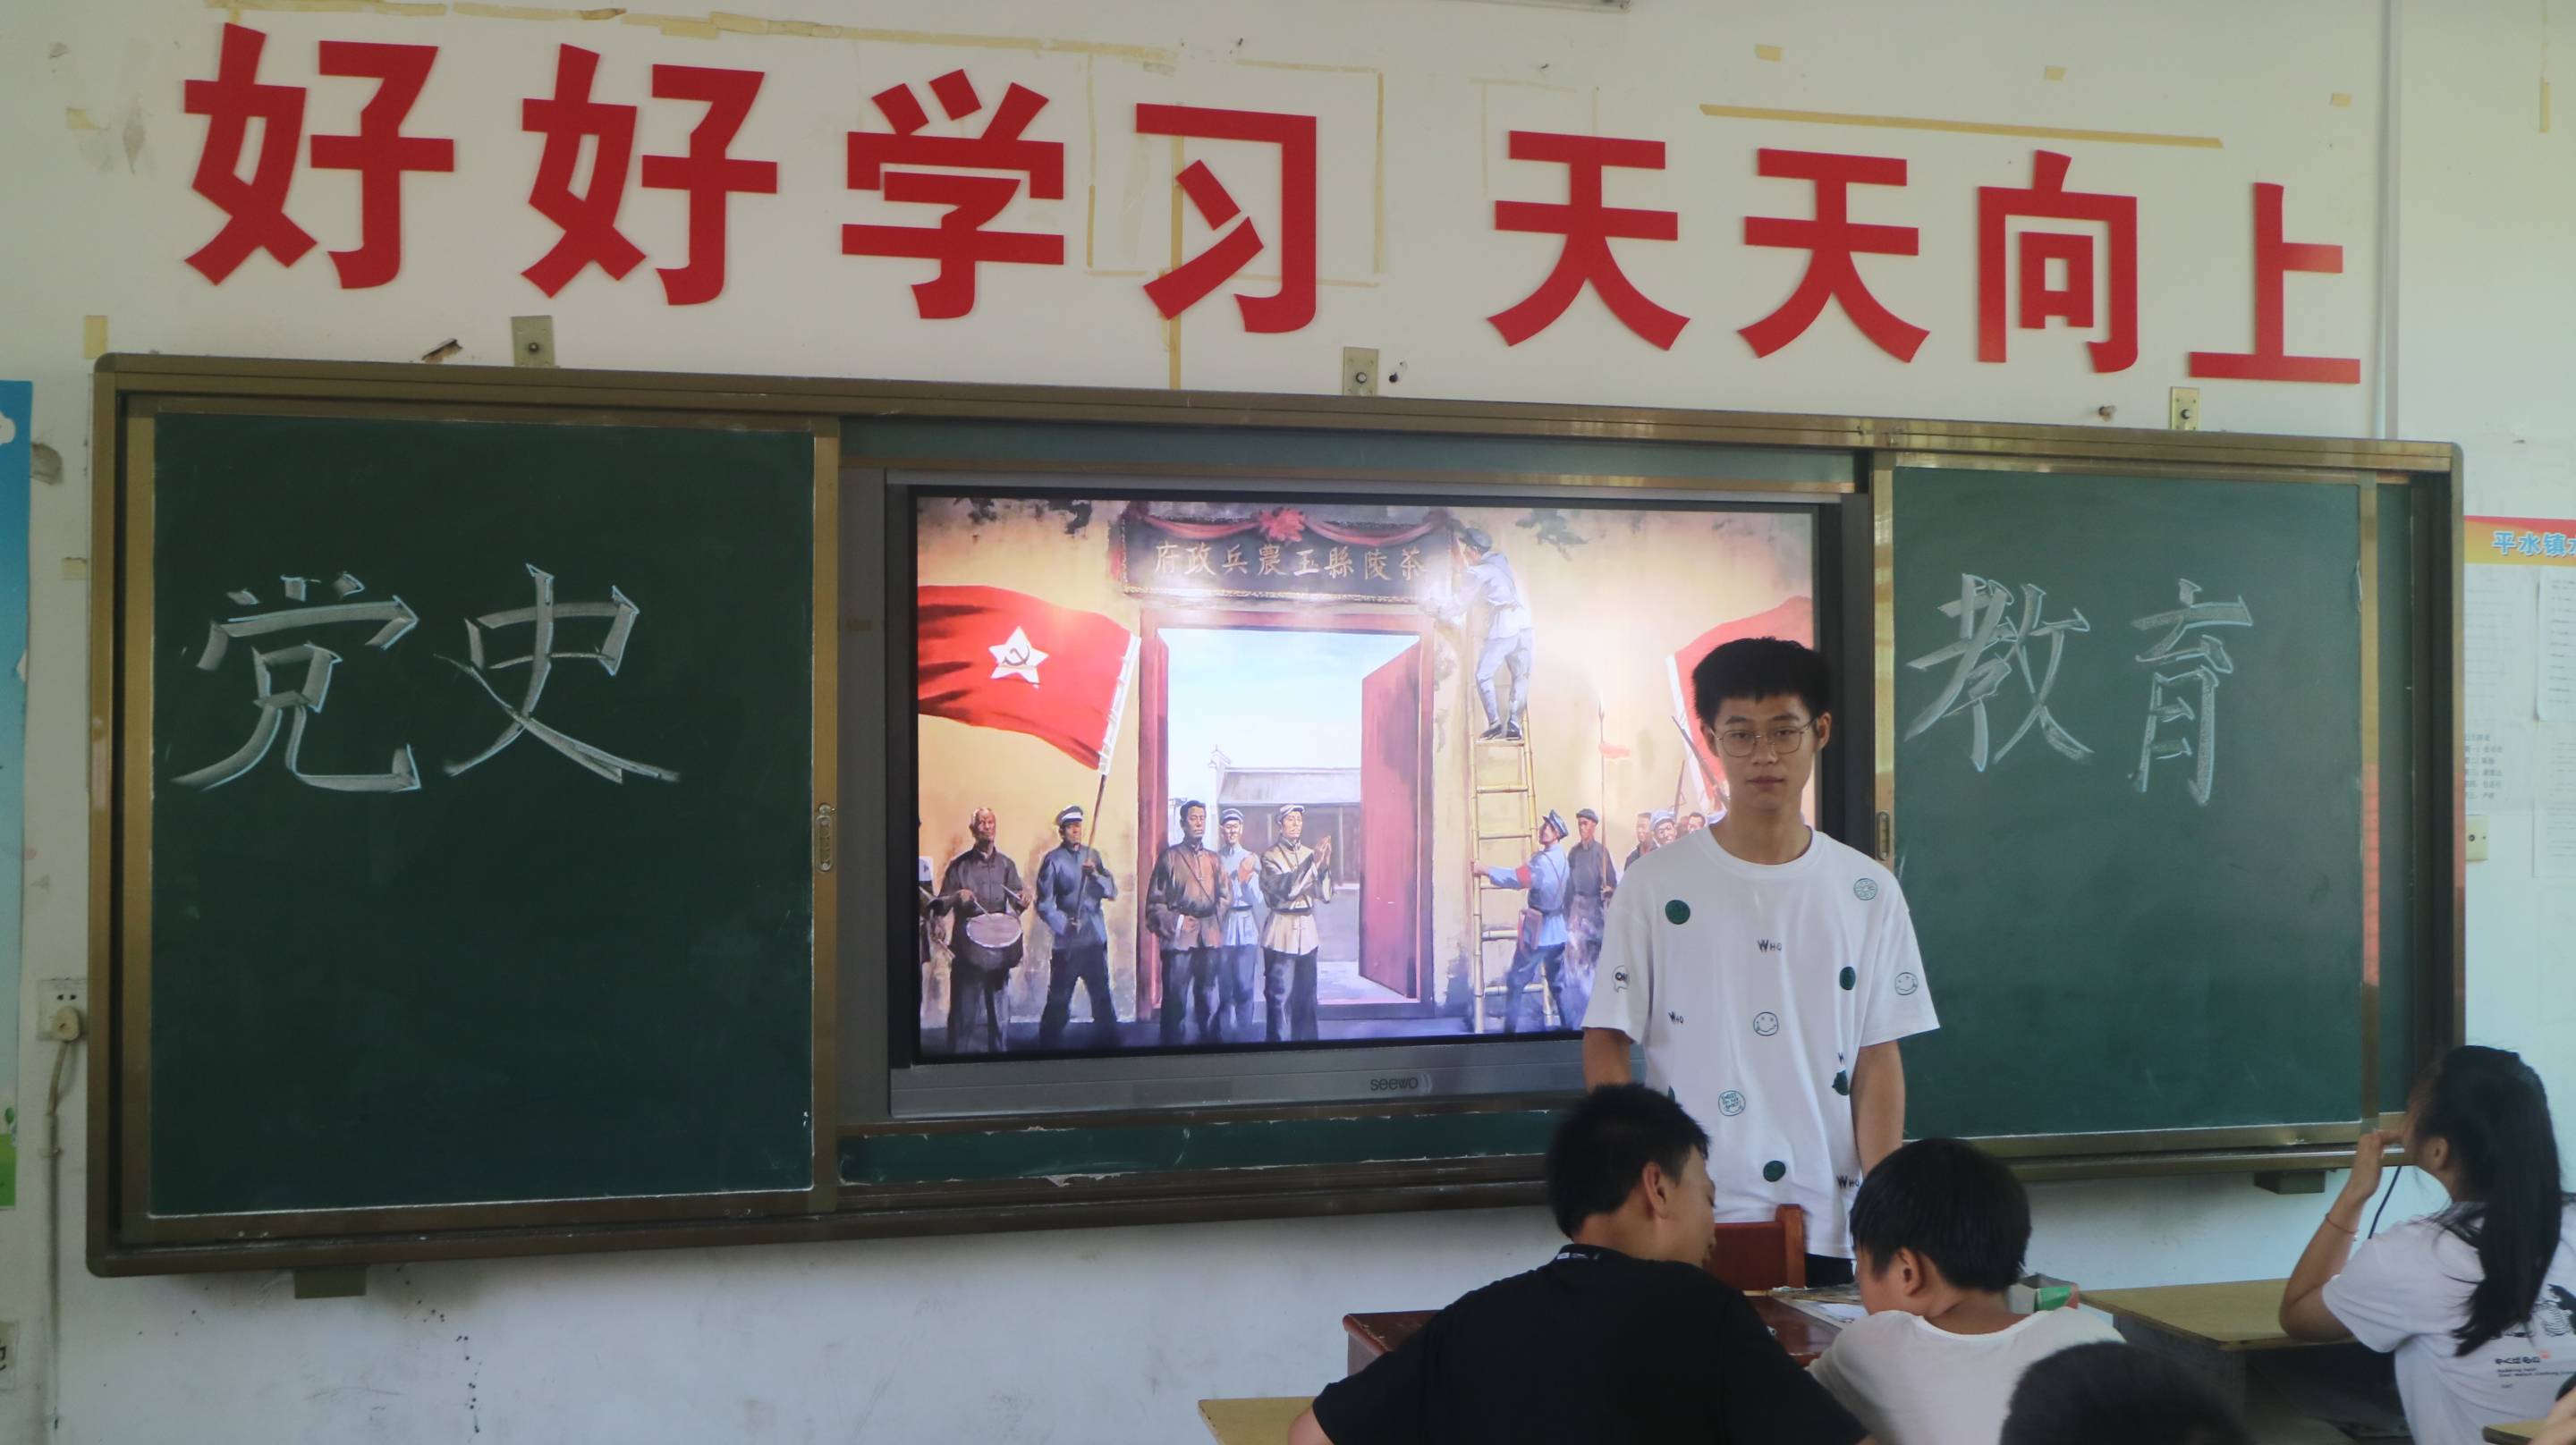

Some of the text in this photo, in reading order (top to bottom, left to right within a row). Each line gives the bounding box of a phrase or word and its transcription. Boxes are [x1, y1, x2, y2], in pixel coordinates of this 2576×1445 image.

[183, 21, 1318, 334] 好好学习
[1487, 130, 2361, 384] 天天向上
[170, 562, 682, 792] 党史
[1902, 572, 2255, 807] 教育
[1369, 1077, 1419, 1091] seewo
